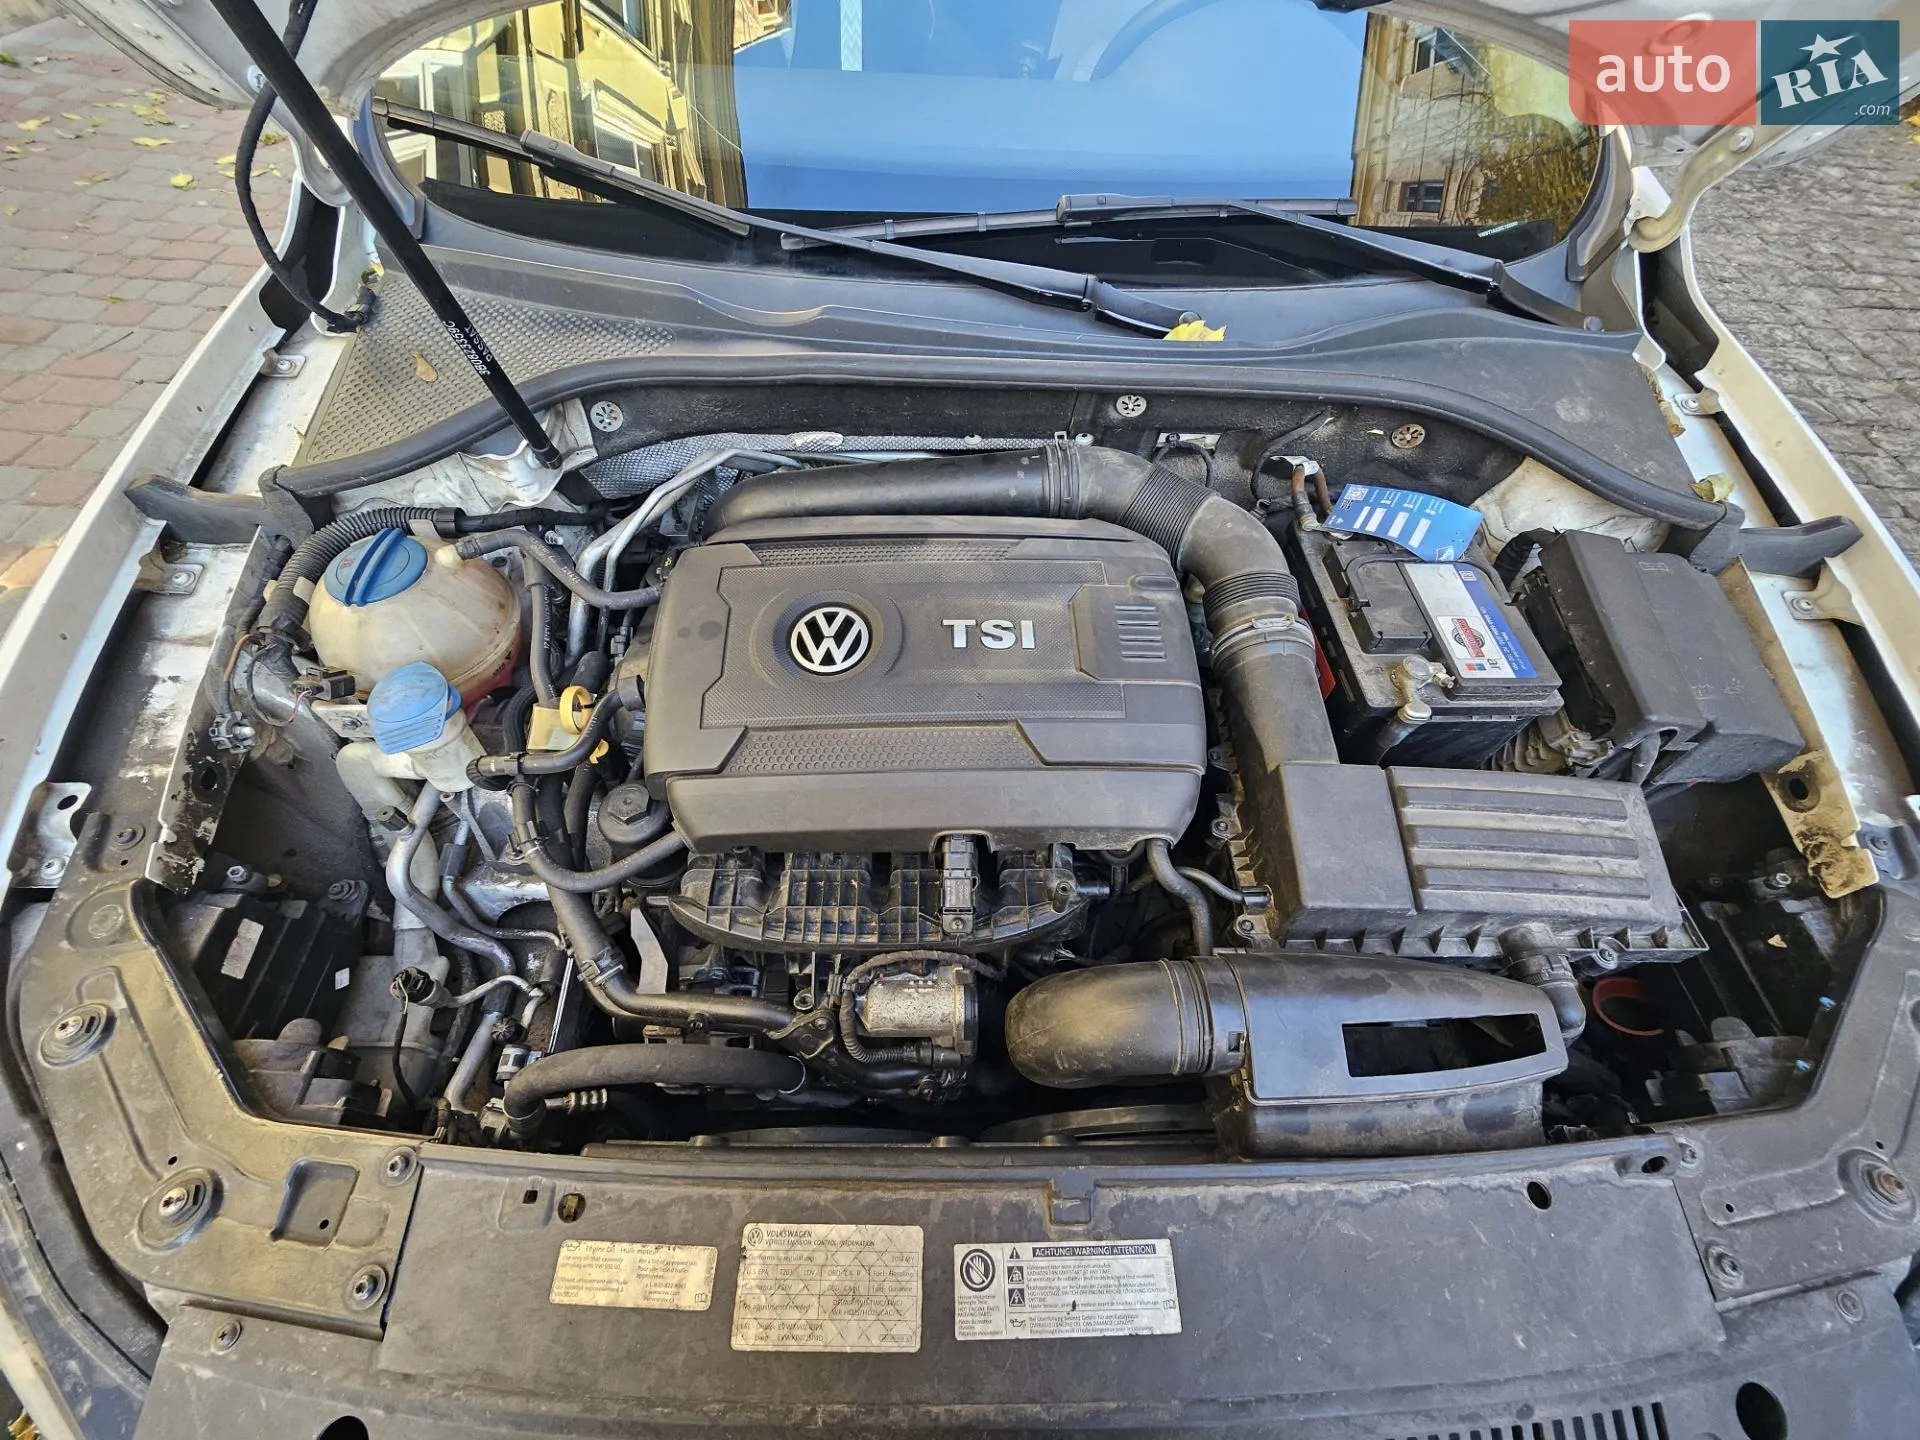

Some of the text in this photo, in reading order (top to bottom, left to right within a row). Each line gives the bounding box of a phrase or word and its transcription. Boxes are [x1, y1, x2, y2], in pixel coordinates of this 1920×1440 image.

[442, 320, 491, 376] 3B0823359C
[463, 323, 493, 362] PASSAT
[942, 619, 1036, 651] TSI
[765, 1229, 812, 1237] VOLKSWAGEN
[1035, 1245, 1154, 1256] ACHTUNG! WARNING! ATTENTION!
